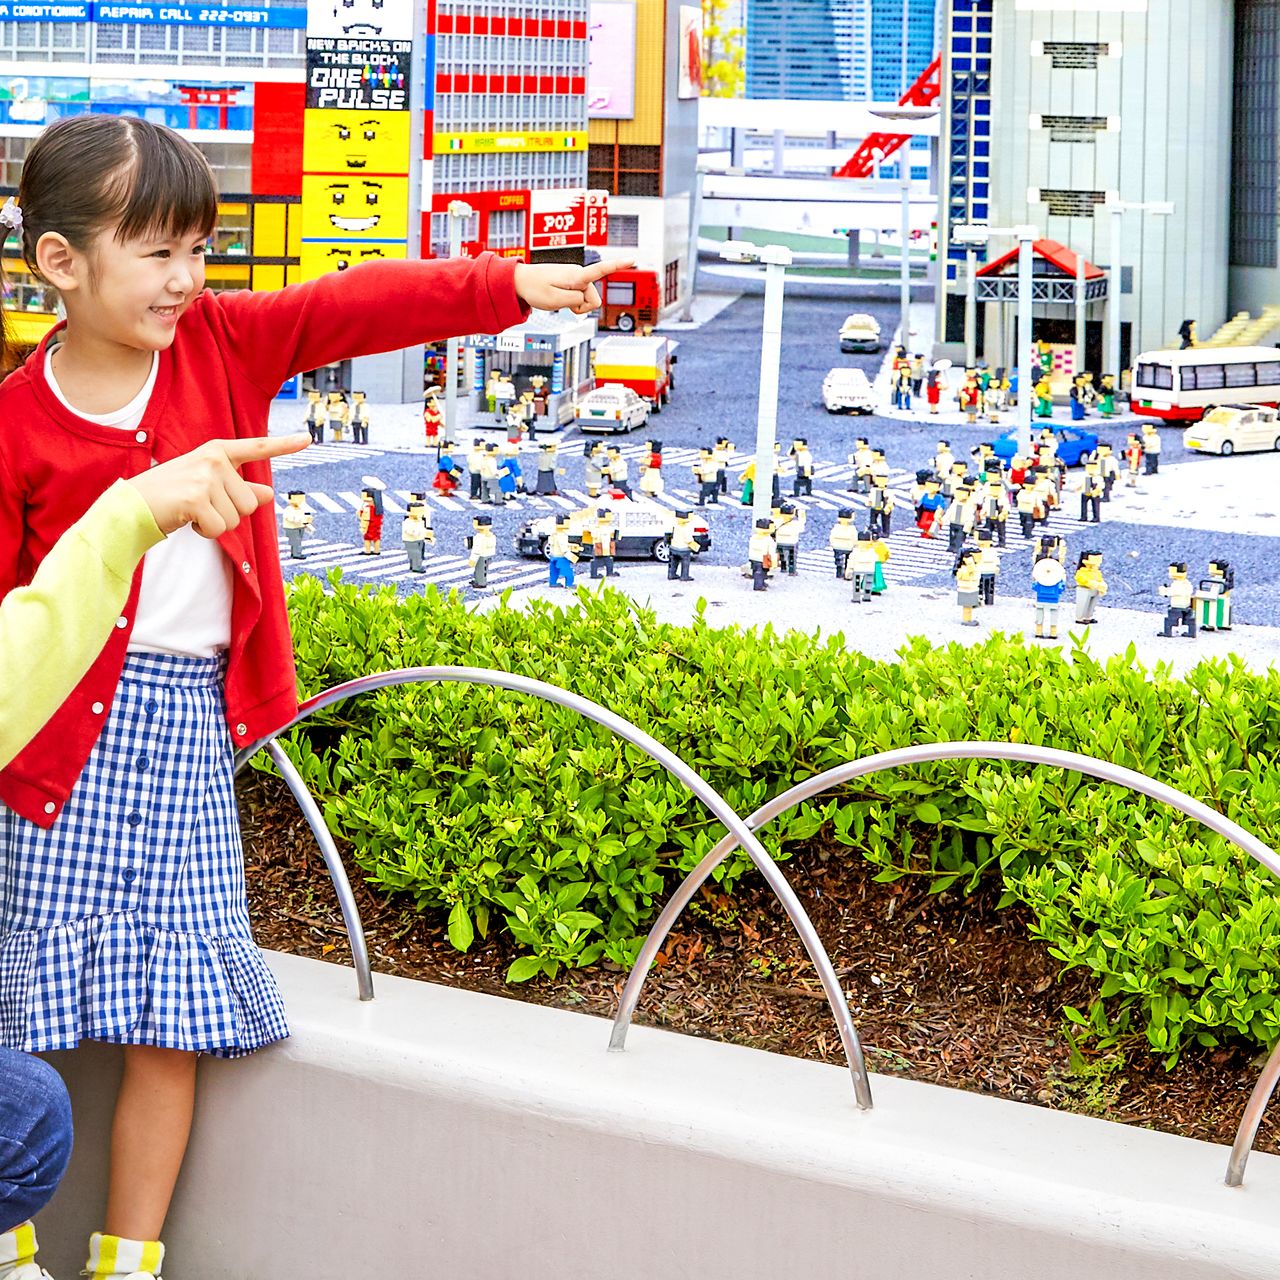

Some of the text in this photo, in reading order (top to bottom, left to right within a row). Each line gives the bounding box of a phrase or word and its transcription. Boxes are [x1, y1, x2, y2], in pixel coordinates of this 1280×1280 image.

[100, 6, 268, 23] REPAIR CALL 222-0937
[307, 38, 412, 53] NEW BRICKS ON
[320, 52, 399, 66] THE BLOCK
[310, 67, 362, 89] ONE
[318, 88, 406, 110] PULSE
[499, 195, 524, 206] COFFEE
[543, 215, 575, 232] POP
[589, 207, 597, 236] POP
